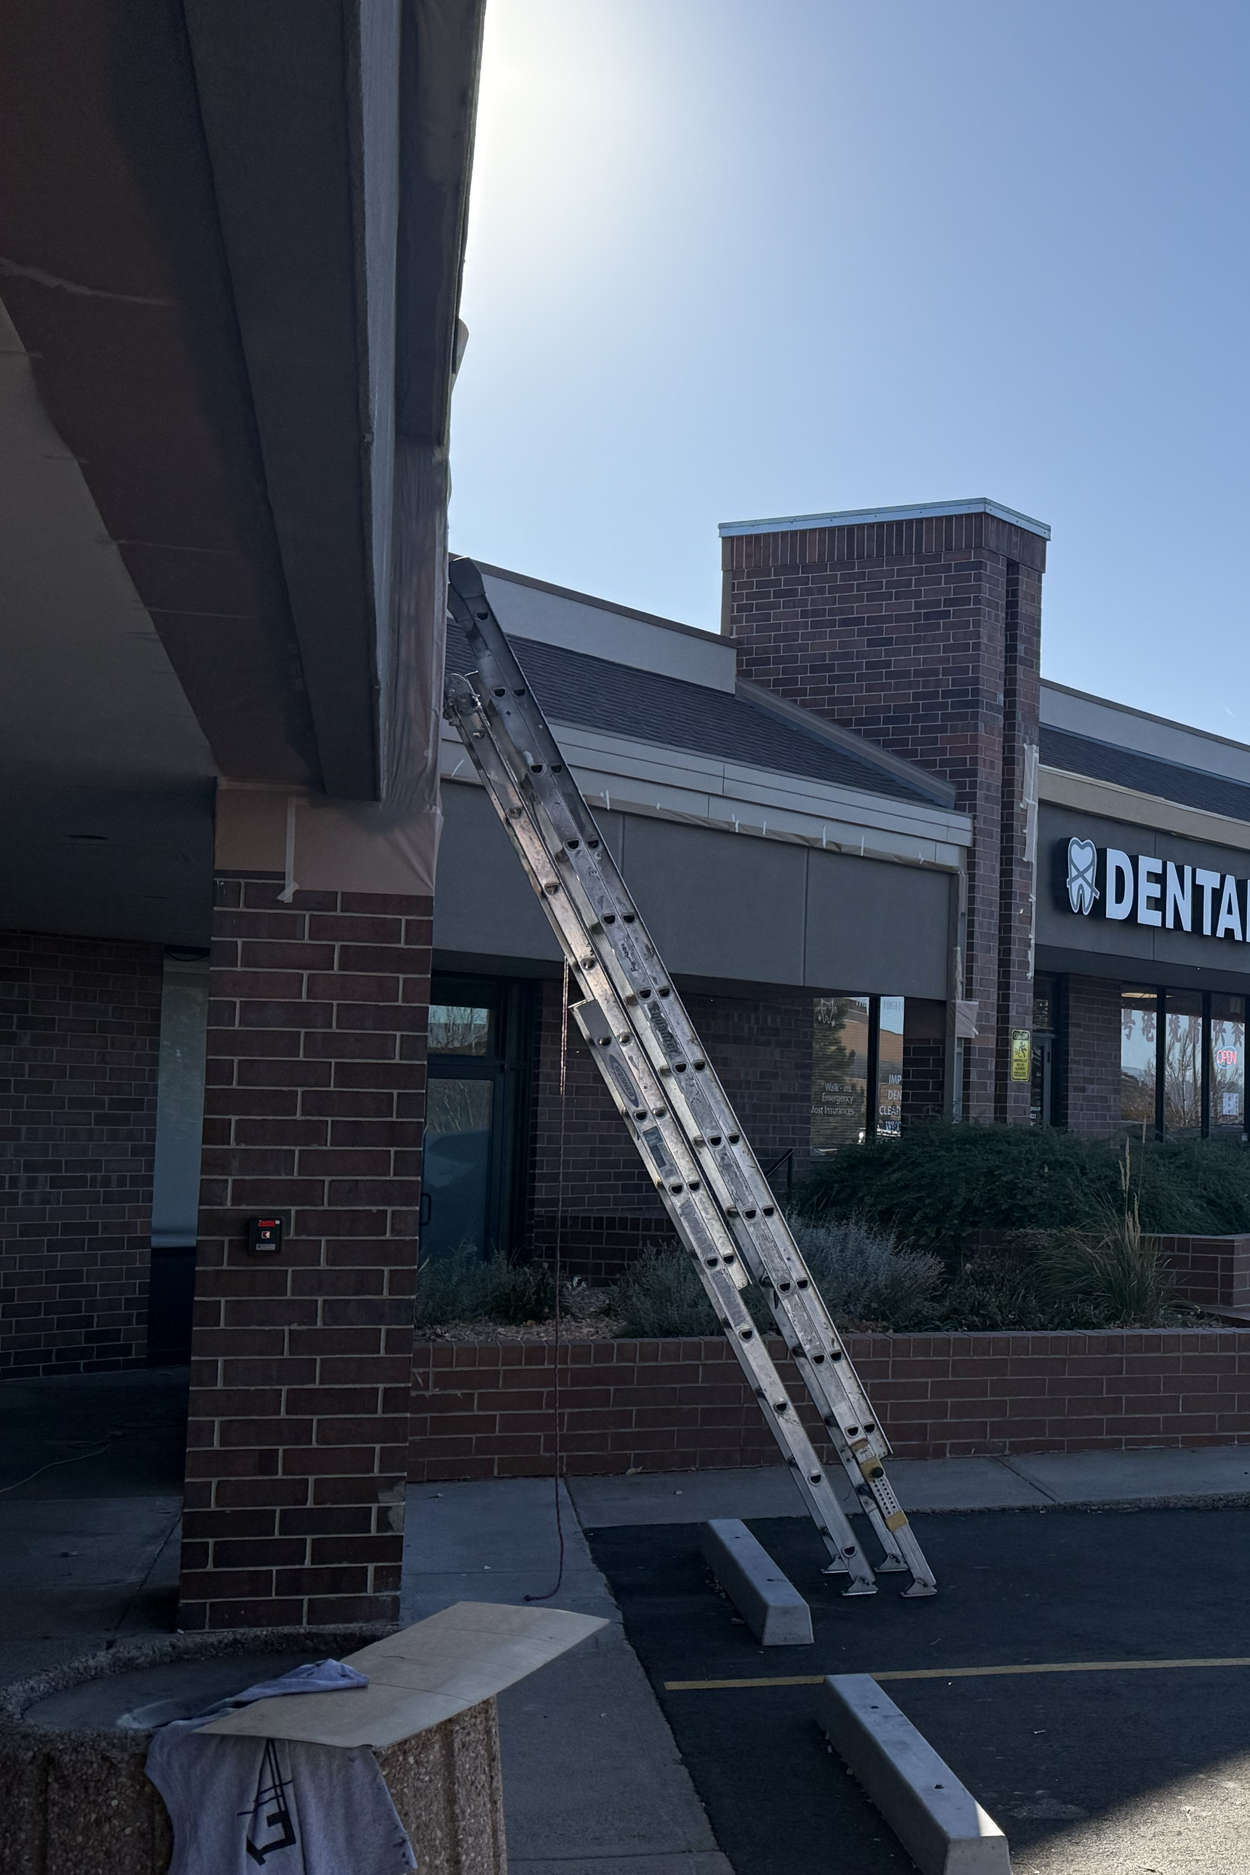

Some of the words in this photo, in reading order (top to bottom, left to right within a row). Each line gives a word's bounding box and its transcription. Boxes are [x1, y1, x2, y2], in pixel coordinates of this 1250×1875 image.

[1216, 1050, 1237, 1065] OPEN
[613, 1063, 635, 1098] WERNER
[821, 1092, 854, 1104] Emergency
[824, 1105, 855, 1116] Insurances
